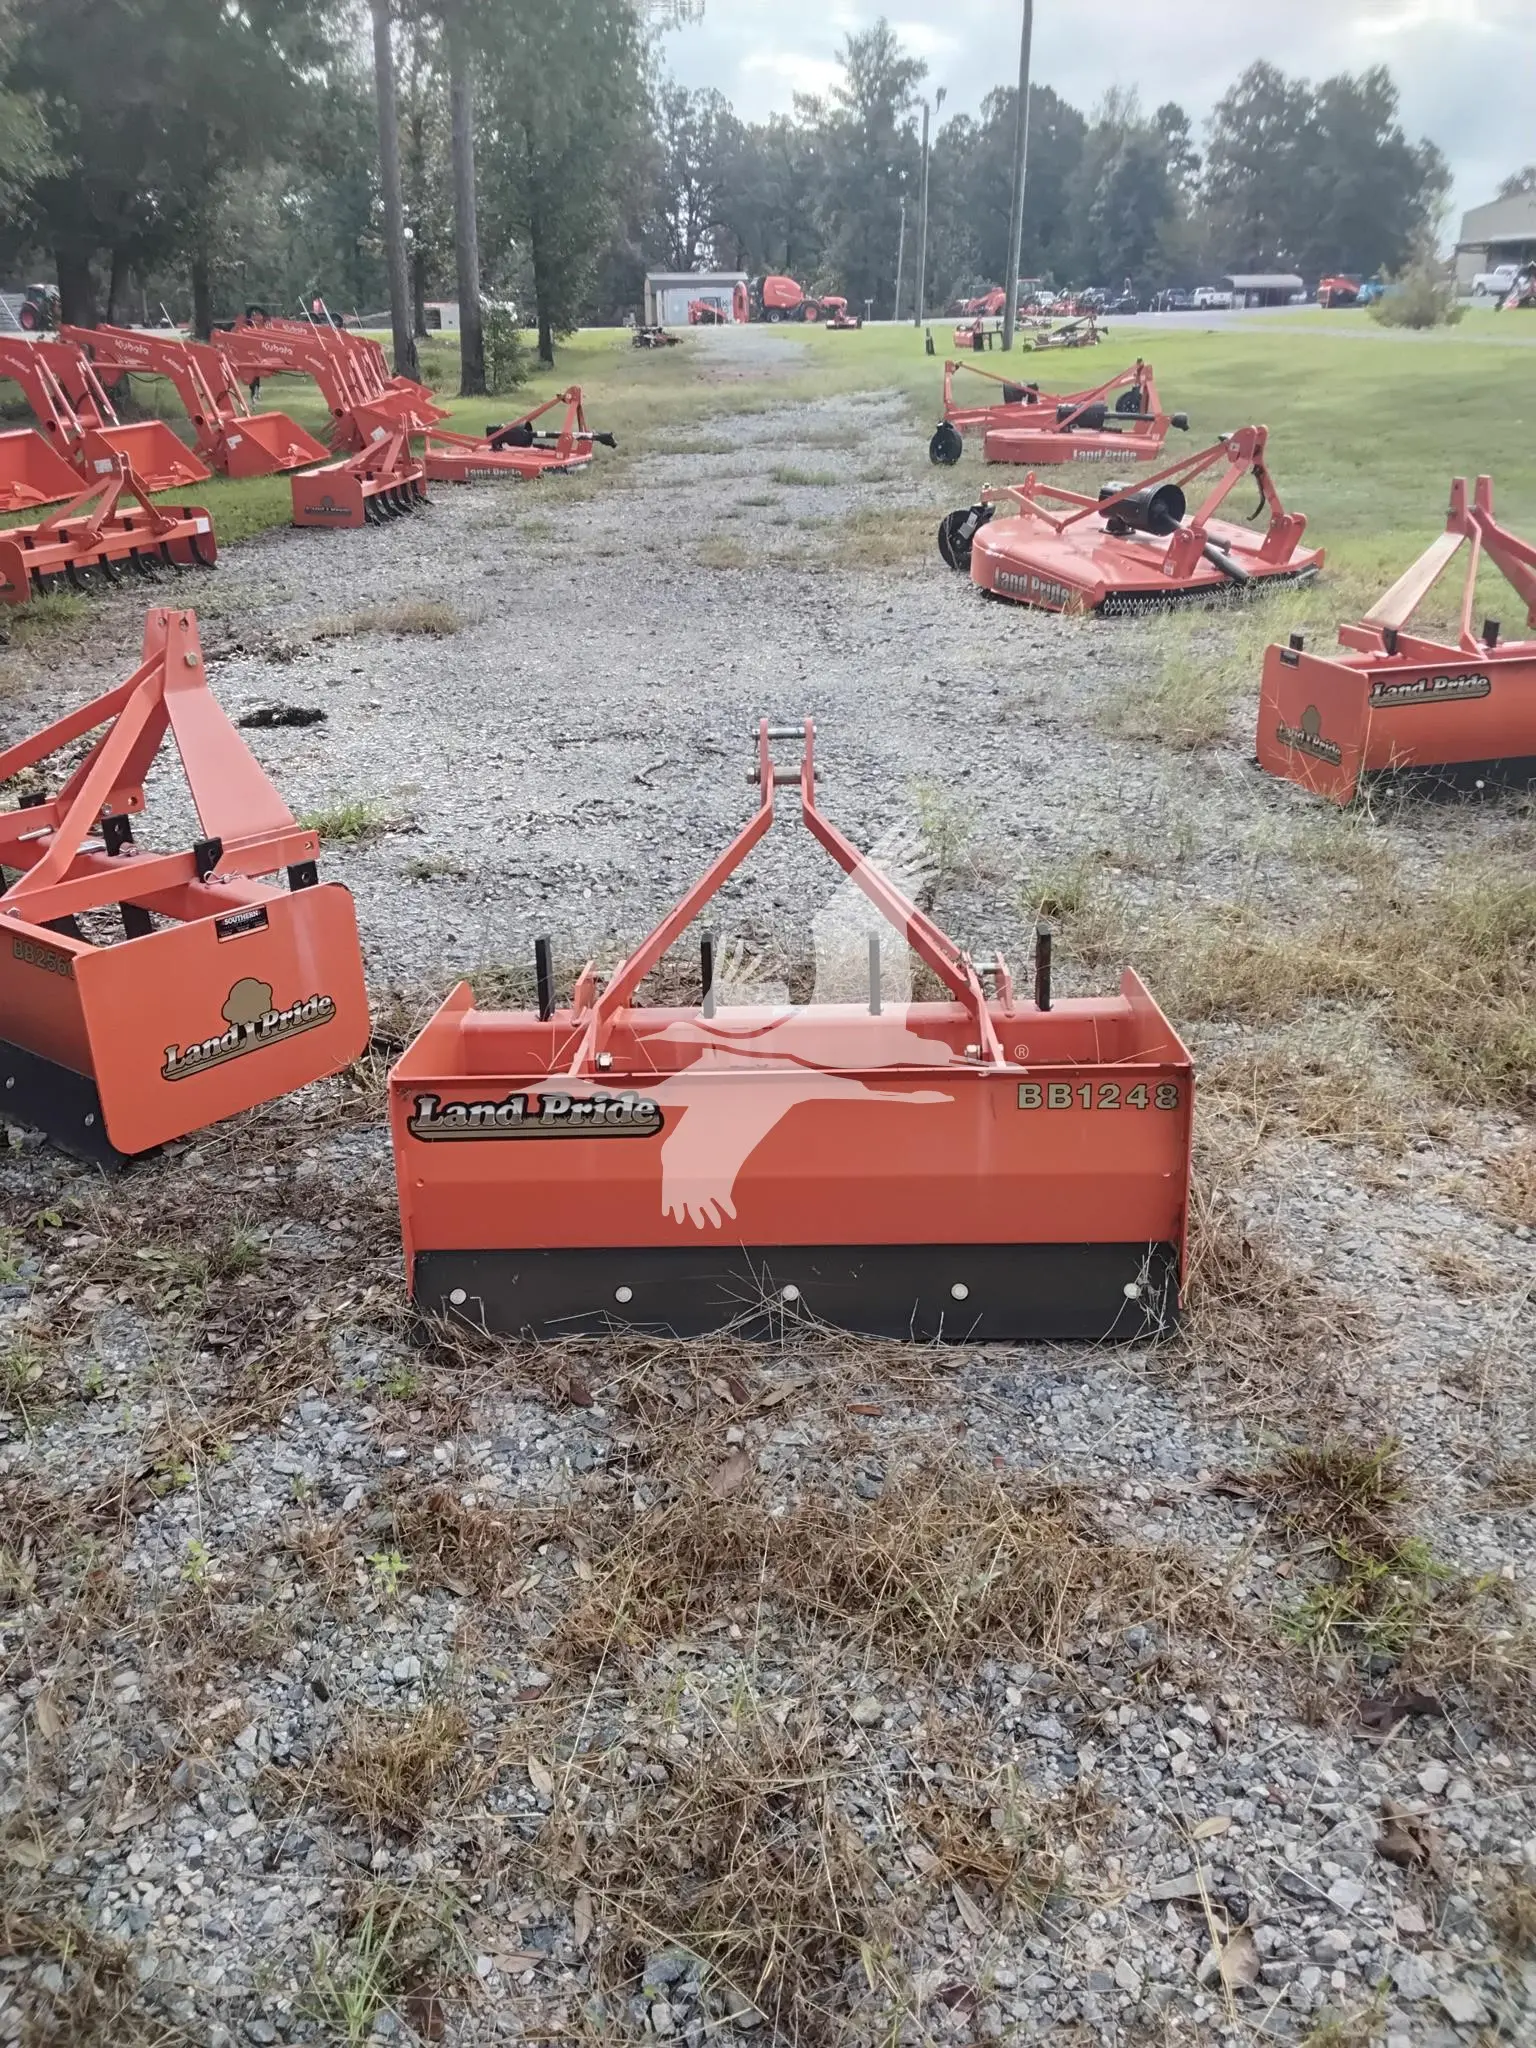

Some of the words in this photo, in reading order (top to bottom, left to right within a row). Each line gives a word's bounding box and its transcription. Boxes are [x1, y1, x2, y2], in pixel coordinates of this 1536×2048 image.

[114, 339, 150, 356] Kubota
[261, 341, 294, 356] Kubota
[1072, 448, 1102, 462] Land
[994, 566, 1028, 594] Land
[1031, 575, 1070, 602] Pride
[1371, 678, 1428, 699] Land
[1433, 674, 1490, 692] Pride
[1278, 720, 1305, 742] Land
[224, 909, 260, 926] SOUTHERN
[163, 1022, 247, 1074] Land
[259, 993, 332, 1038] Pride
[1017, 1083, 1179, 1110] BB1248
[415, 1095, 526, 1128] Land
[540, 1094, 656, 1126] Pride
